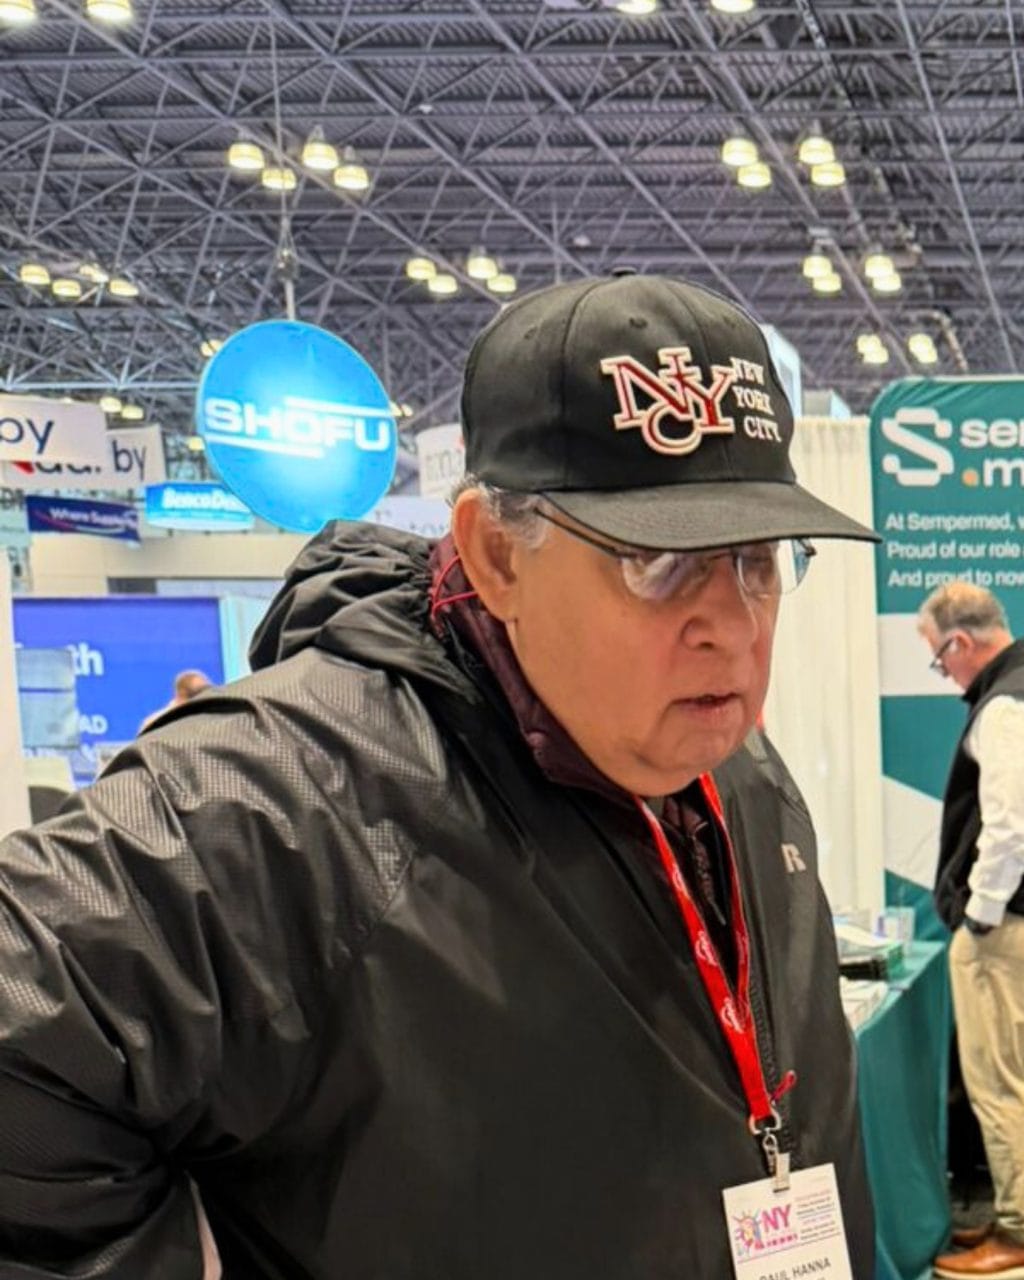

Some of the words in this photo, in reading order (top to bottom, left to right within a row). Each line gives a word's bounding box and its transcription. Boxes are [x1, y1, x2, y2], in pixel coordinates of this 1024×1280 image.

[730, 356, 764, 385] NEW
[733, 386, 774, 415] YORK
[205, 398, 390, 451] SHOFU
[743, 416, 782, 442] CITY
[112, 440, 147, 480] by
[885, 513, 904, 530] At
[907, 512, 1014, 533] Sempermed,
[887, 541, 936, 559] Proud
[939, 540, 956, 558] of
[959, 544, 987, 558] our
[990, 540, 1020, 558] role
[888, 569, 922, 587] And
[976, 570, 992, 587] to
[761, 1203, 792, 1235] NY
[792, 1257, 831, 1278] HANNA
